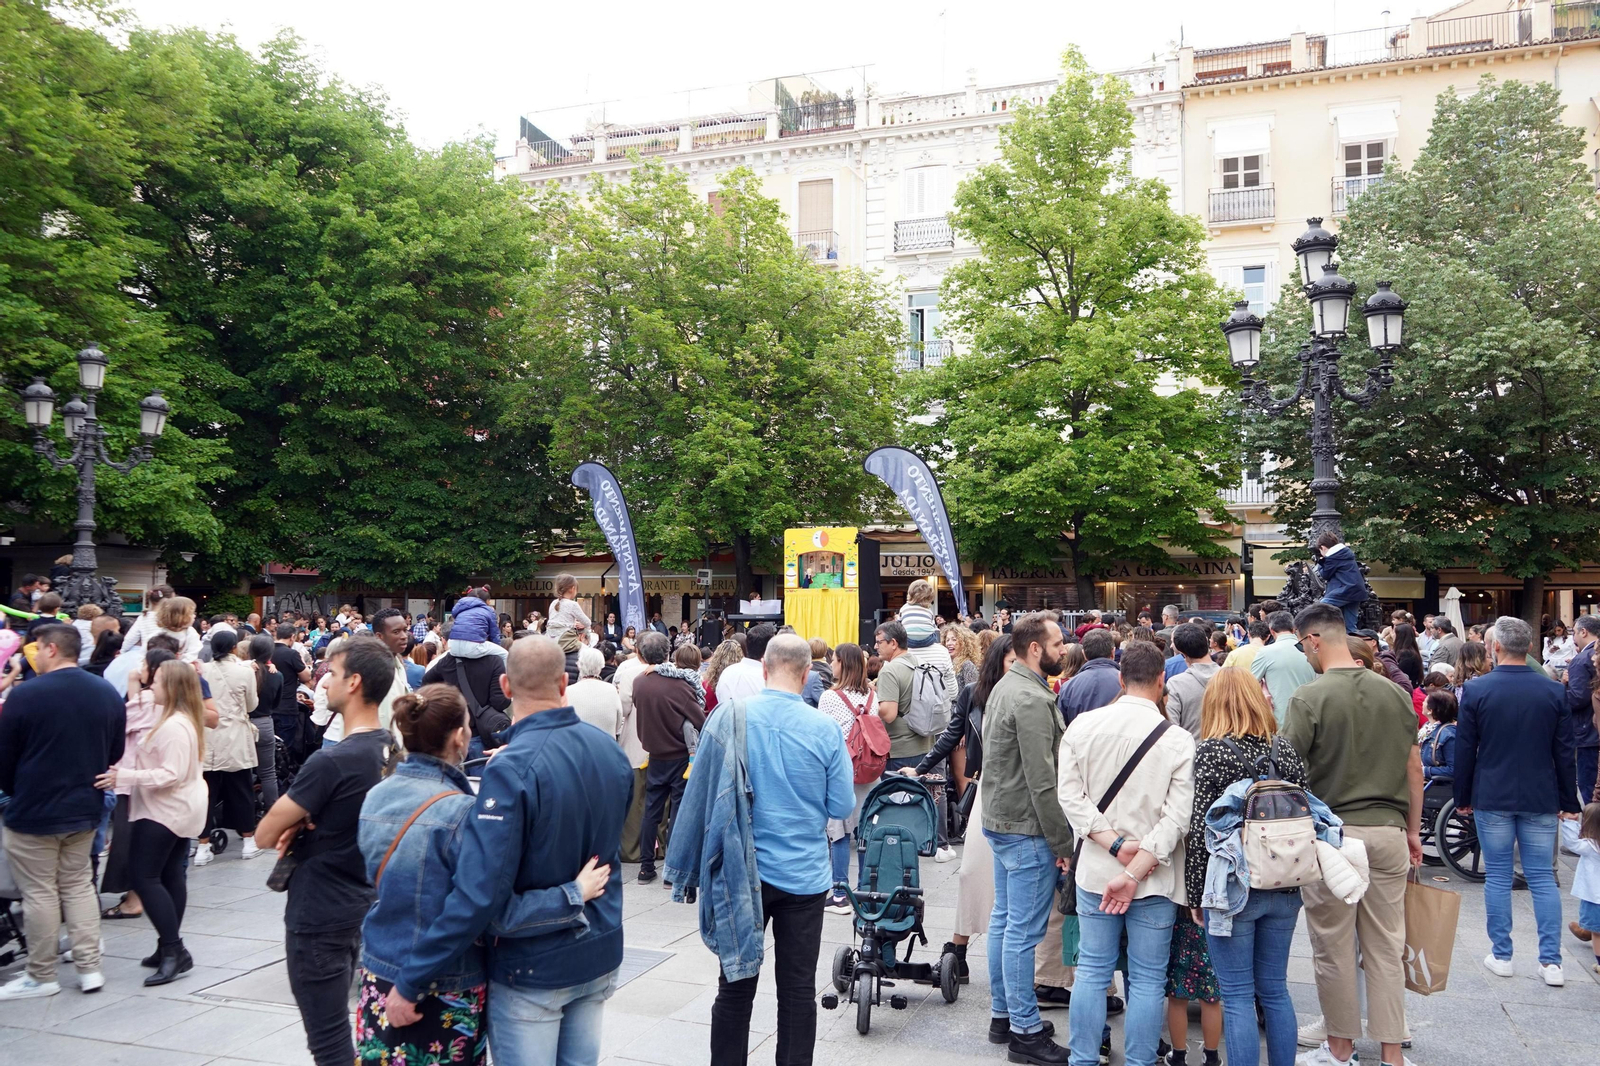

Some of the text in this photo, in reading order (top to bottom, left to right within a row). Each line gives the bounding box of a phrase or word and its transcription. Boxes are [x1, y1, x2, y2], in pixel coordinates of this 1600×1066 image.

[881, 555, 935, 568] JULIO
[892, 568, 936, 576] desde 1947
[988, 565, 1068, 580] TABERNA
[514, 580, 553, 591] GALLIO
[643, 580, 680, 591] ORANTE
[1404, 943, 1432, 988] RA
